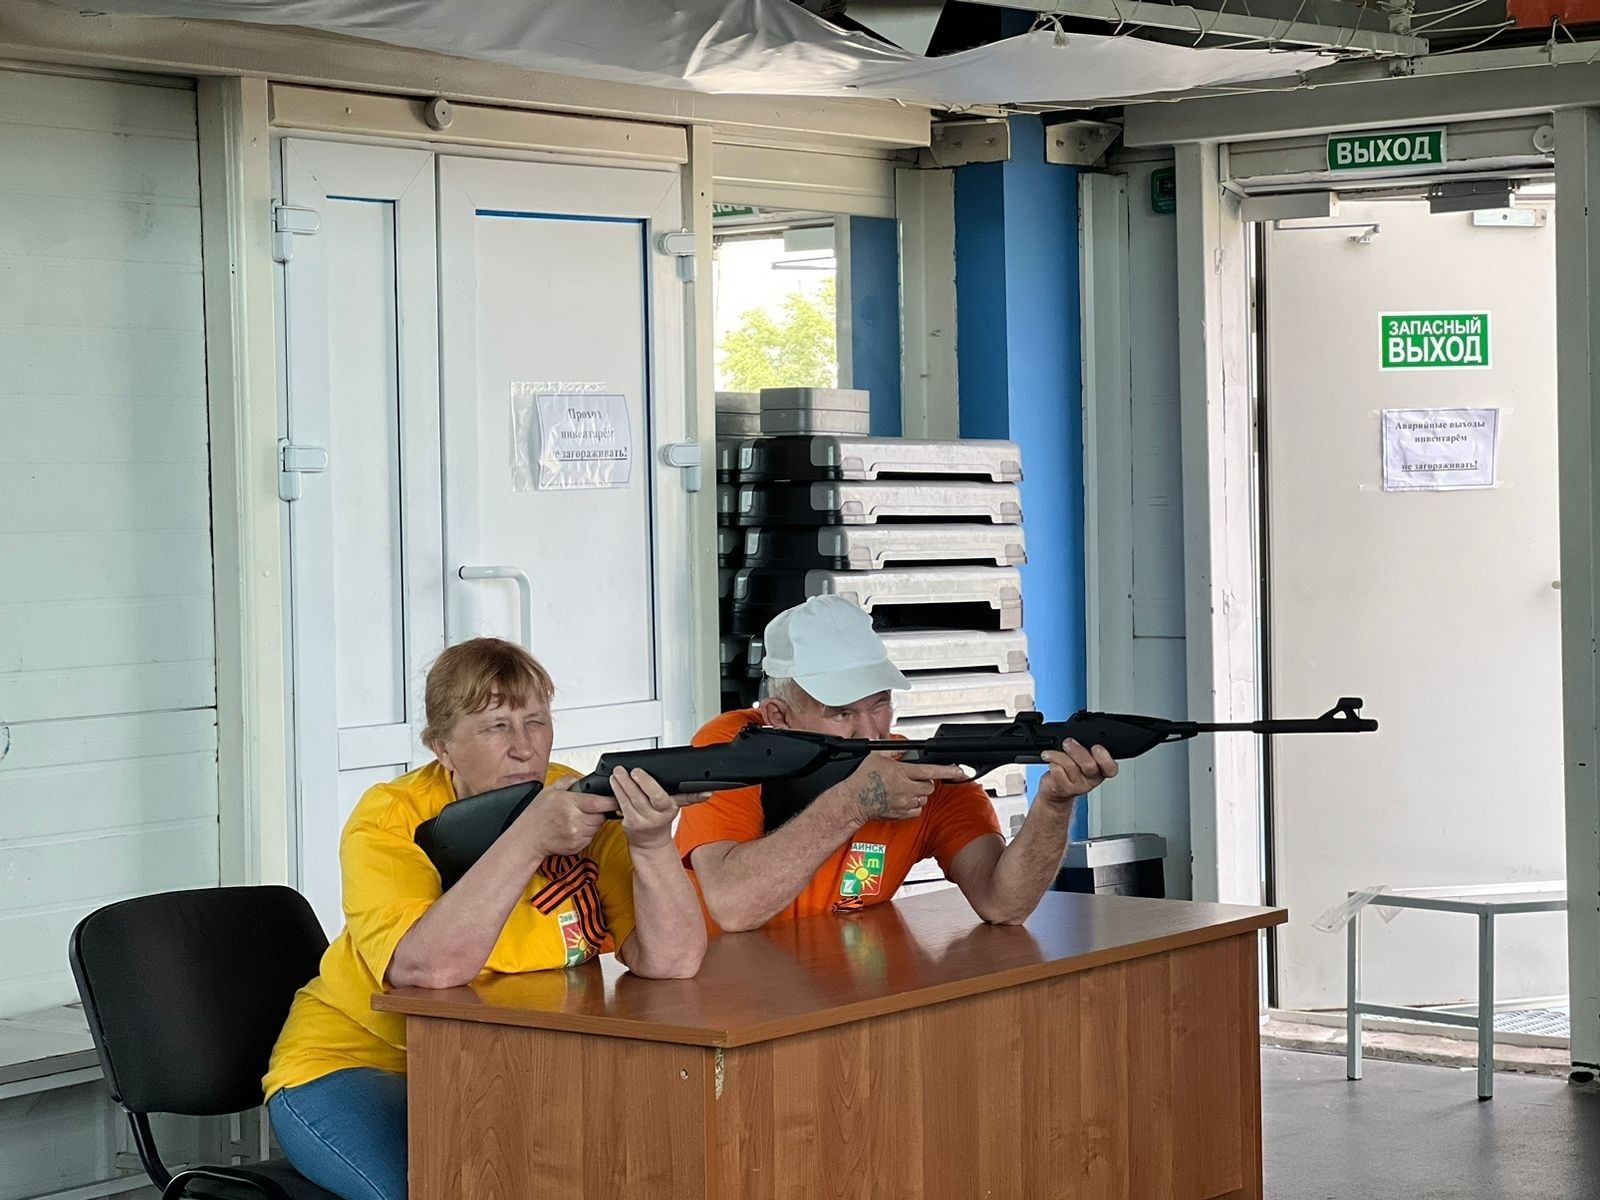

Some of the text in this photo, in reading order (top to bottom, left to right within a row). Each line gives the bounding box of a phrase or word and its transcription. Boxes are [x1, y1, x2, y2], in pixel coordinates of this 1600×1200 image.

[1337, 136, 1432, 165] ВЫХОД
[1389, 316, 1481, 335] ЗАПАСНЫЙ
[1389, 335, 1482, 363] ВЫХОД
[1395, 420, 1485, 431] Аварийные выходы
[1414, 434, 1467, 443] инвентарём
[562, 446, 627, 459] загораживать!
[1414, 460, 1478, 471] загораживать!
[852, 843, 884, 852] АИНСК
